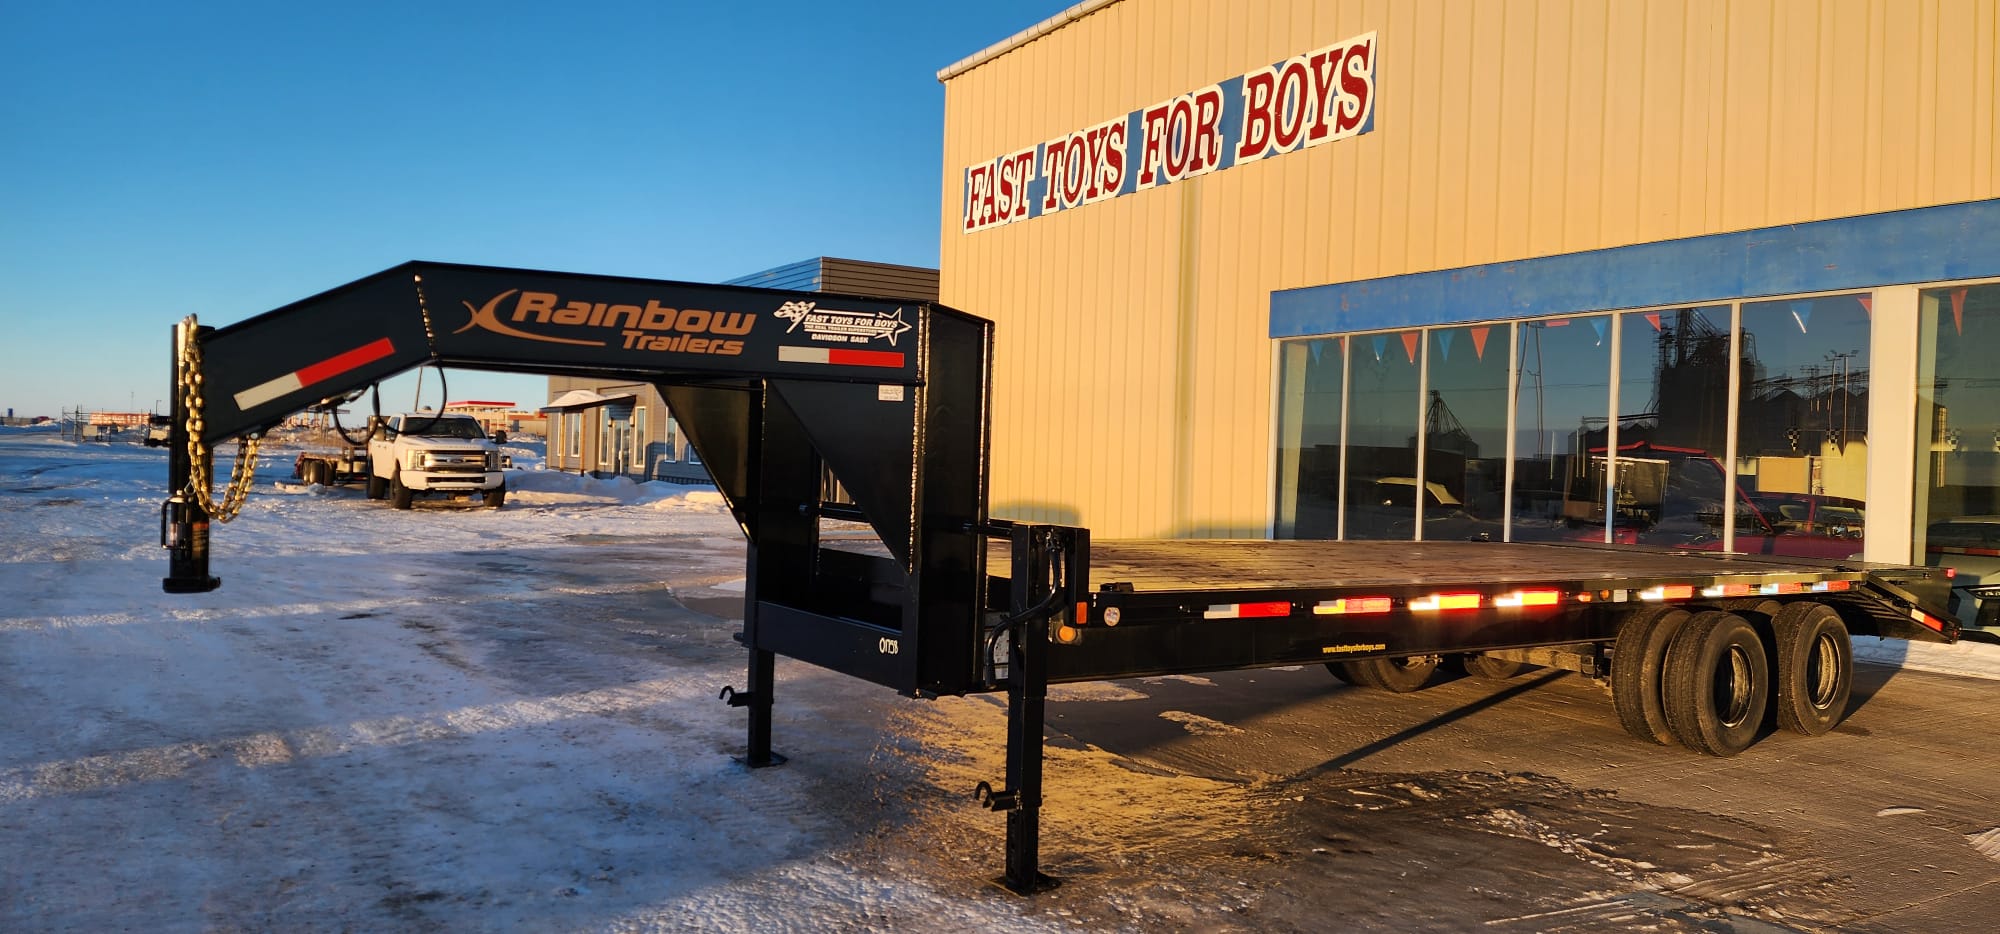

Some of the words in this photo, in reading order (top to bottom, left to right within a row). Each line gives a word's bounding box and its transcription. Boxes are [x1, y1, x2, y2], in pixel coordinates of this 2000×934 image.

[966, 151, 1034, 229] FAST
[1043, 120, 1127, 209] TOYS
[1140, 89, 1222, 184] FOR
[1239, 39, 1372, 158] BOYS
[512, 291, 758, 336] Rainbow
[805, 314, 829, 323] FAST
[830, 315, 854, 325] TOYS
[854, 317, 873, 326] FOR
[874, 319, 898, 328] BOYS
[621, 330, 745, 356] Trailers
[811, 333, 848, 342] DAVIDSON
[1322, 643, 1386, 653] www.fasttoysforboys.com
